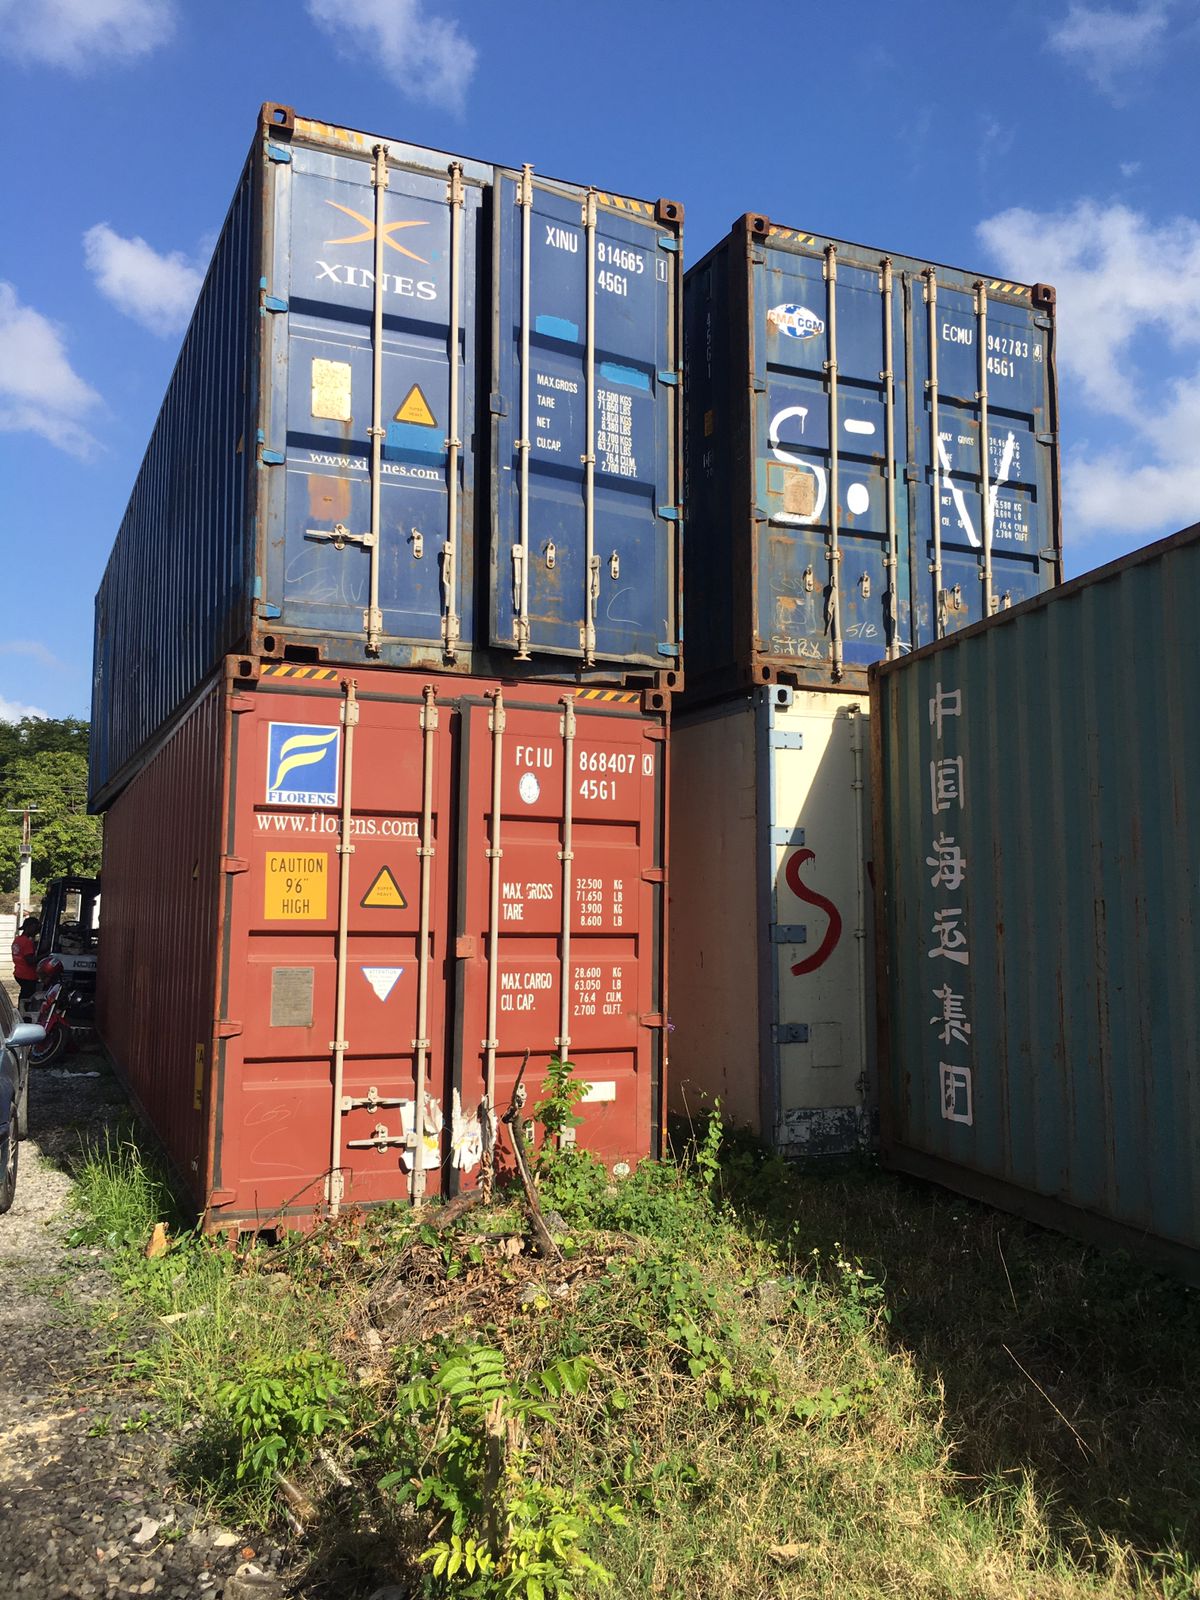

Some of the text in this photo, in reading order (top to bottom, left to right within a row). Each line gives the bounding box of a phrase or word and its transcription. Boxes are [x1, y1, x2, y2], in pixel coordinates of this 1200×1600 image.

[545, 225, 578, 253] XINU
[598, 242, 644, 274] 814665
[315, 260, 438, 301] XINES
[598, 269, 628, 297] 45G1
[768, 311, 823, 333] CMA CGM
[942, 323, 972, 345] ECMU
[987, 335, 1028, 358] 942783
[987, 356, 1014, 378] 45G1
[537, 394, 556, 409] TARE
[537, 416, 551, 429] NET
[769, 406, 827, 525] S
[941, 496, 952, 506] NET
[1013, 502, 1022, 513] KG
[515, 745, 553, 768] FCIU
[579, 751, 636, 774] 868407
[268, 791, 336, 805] FLORENS
[579, 779, 616, 801] 45G1
[270, 857, 323, 873] CAUTION
[502, 882, 553, 899] MAX. GROSS
[576, 879, 623, 890] 32.500 KG
[576, 891, 623, 902] 71.650 LB
[925, 681, 973, 1127] 中国海运集团
[282, 898, 310, 914] HIGH
[502, 903, 524, 920] TARE
[580, 903, 623, 914] 3.900 KG
[785, 848, 842, 977] S
[580, 915, 623, 926] 8.600 LB
[574, 967, 622, 978] 28.600 KG
[501, 973, 552, 990] MAX. CARGO
[574, 979, 622, 990] 63.050 LB
[501, 993, 536, 1011] CU. CAP.
[579, 992, 596, 1003] 76.4
[574, 1005, 596, 1016] 2.700
